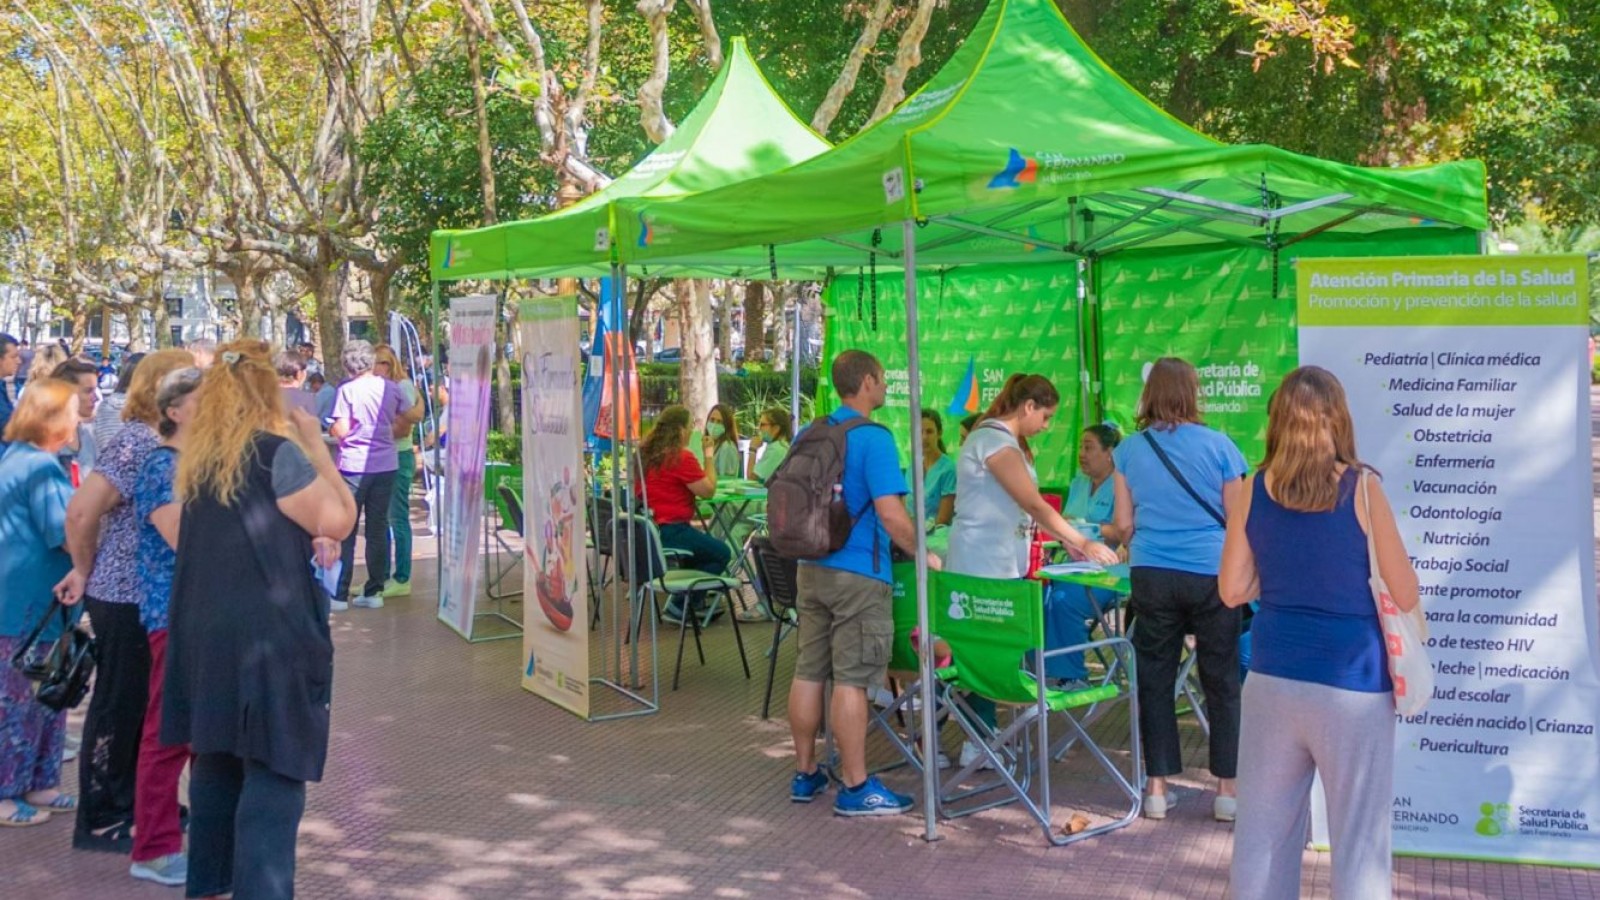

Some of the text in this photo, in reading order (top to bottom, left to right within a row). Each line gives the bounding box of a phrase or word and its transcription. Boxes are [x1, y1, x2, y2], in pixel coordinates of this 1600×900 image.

[1309, 269, 1574, 288] Atención Primaria de la Salud
[1309, 291, 1577, 311] Promoción y prevención de la salud
[1364, 352, 1428, 366] Pediatría
[1437, 352, 1485, 366] Clínica
[1487, 352, 1541, 366] médica
[983, 368, 1004, 382] SAN
[1243, 360, 1260, 377] de
[1216, 380, 1262, 397] Pública
[1388, 378, 1517, 392] Medicina Familiar
[1392, 403, 1515, 421] Salud de la mujer
[1413, 428, 1492, 443] Obstetricia
[1414, 454, 1495, 469] Enfermería
[1412, 480, 1497, 495] Vacunación
[1409, 505, 1502, 524] Odontología
[1422, 531, 1490, 546] Nutrición
[1464, 558, 1510, 573] Social
[1418, 585, 1522, 600] ente promotor
[1457, 609, 1470, 623] la
[1473, 611, 1558, 627] comunidad
[1441, 636, 1457, 649] de
[1460, 636, 1505, 651] testeo
[1507, 638, 1535, 652] HIV
[1437, 660, 1475, 675] leche
[1484, 664, 1570, 680] medicación
[1432, 686, 1511, 704] lud escolar
[1430, 713, 1474, 728] recién
[1476, 716, 1527, 731] nacido
[1536, 718, 1594, 735] Crianza
[1419, 738, 1509, 755] Puericultura
[1392, 796, 1411, 807] AN
[1392, 811, 1459, 825] ERNANDO
[1572, 809, 1586, 819] de
[1519, 817, 1589, 831] Salud Pública
